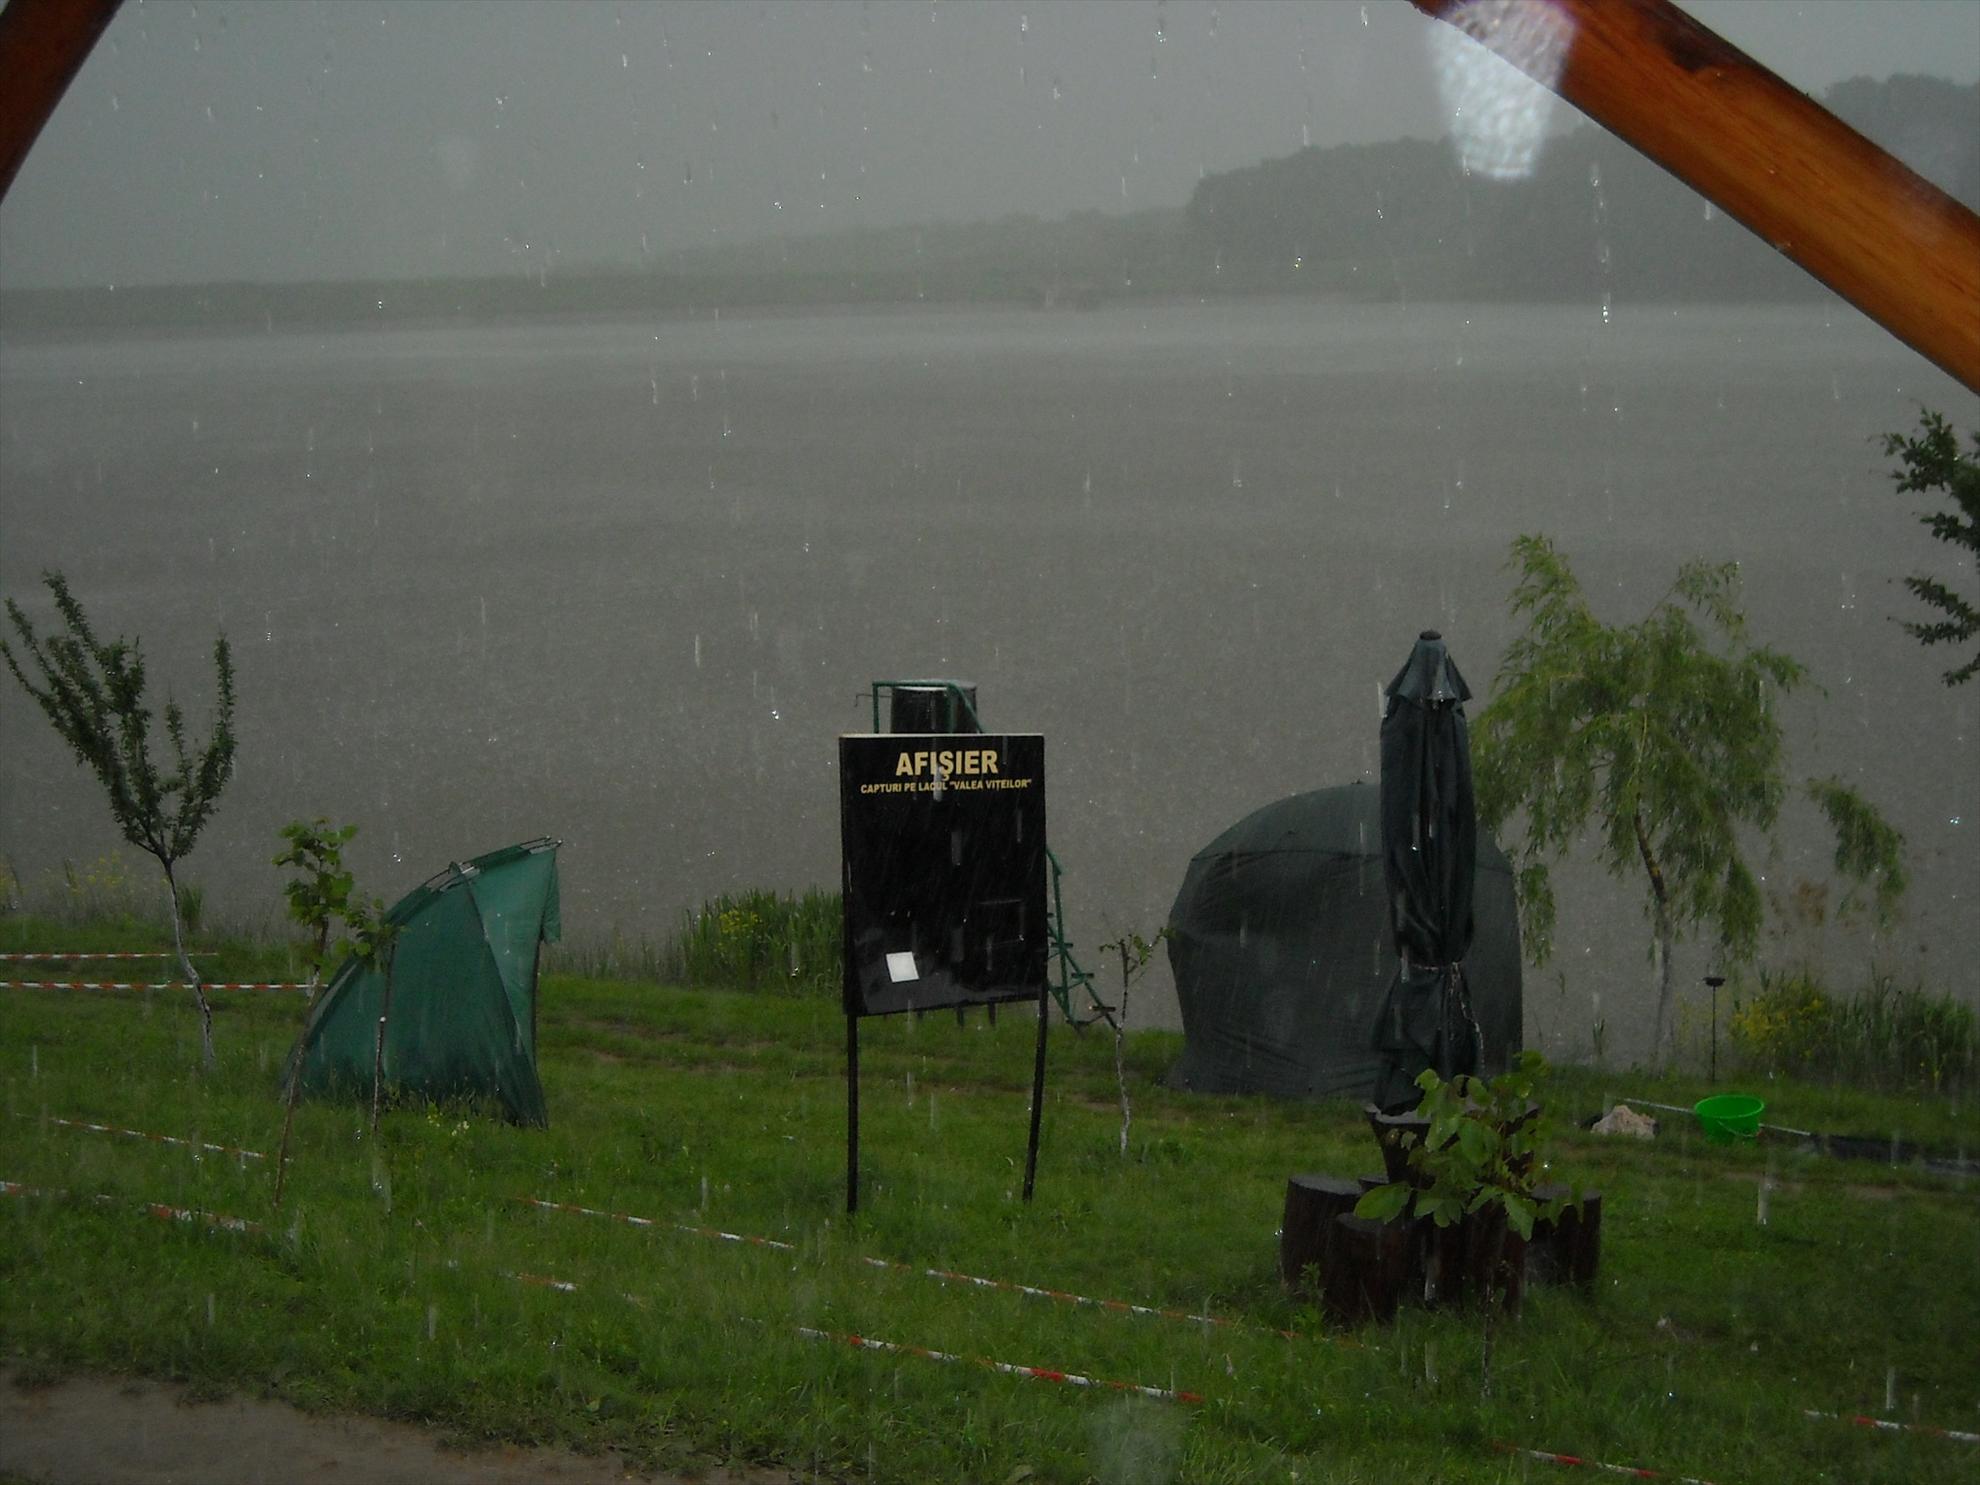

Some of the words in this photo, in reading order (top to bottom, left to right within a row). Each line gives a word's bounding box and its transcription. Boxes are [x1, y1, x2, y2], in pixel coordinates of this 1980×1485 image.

[860, 783, 902, 794] CAPTURI
[904, 782, 916, 792] PE
[918, 781, 948, 791] LACUL
